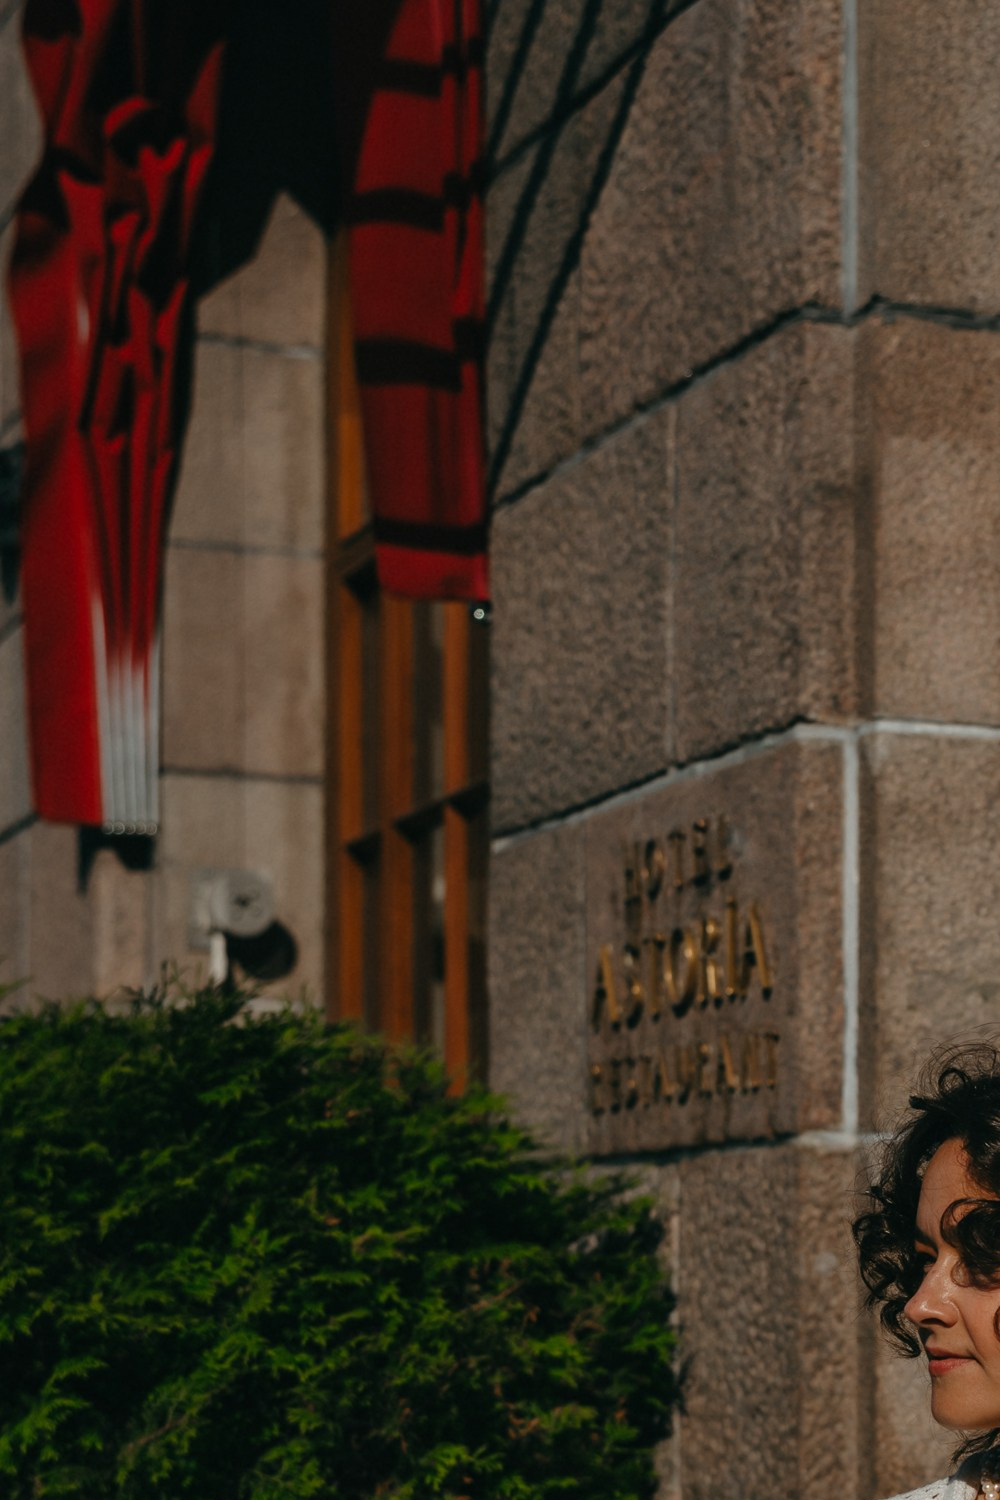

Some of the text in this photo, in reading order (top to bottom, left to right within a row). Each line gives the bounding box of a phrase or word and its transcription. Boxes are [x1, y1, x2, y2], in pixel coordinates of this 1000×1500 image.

[622, 816, 733, 902] HOTEL
[592, 896, 773, 1031] ASTORIA
[591, 1032, 780, 1116] RESTAURANT
